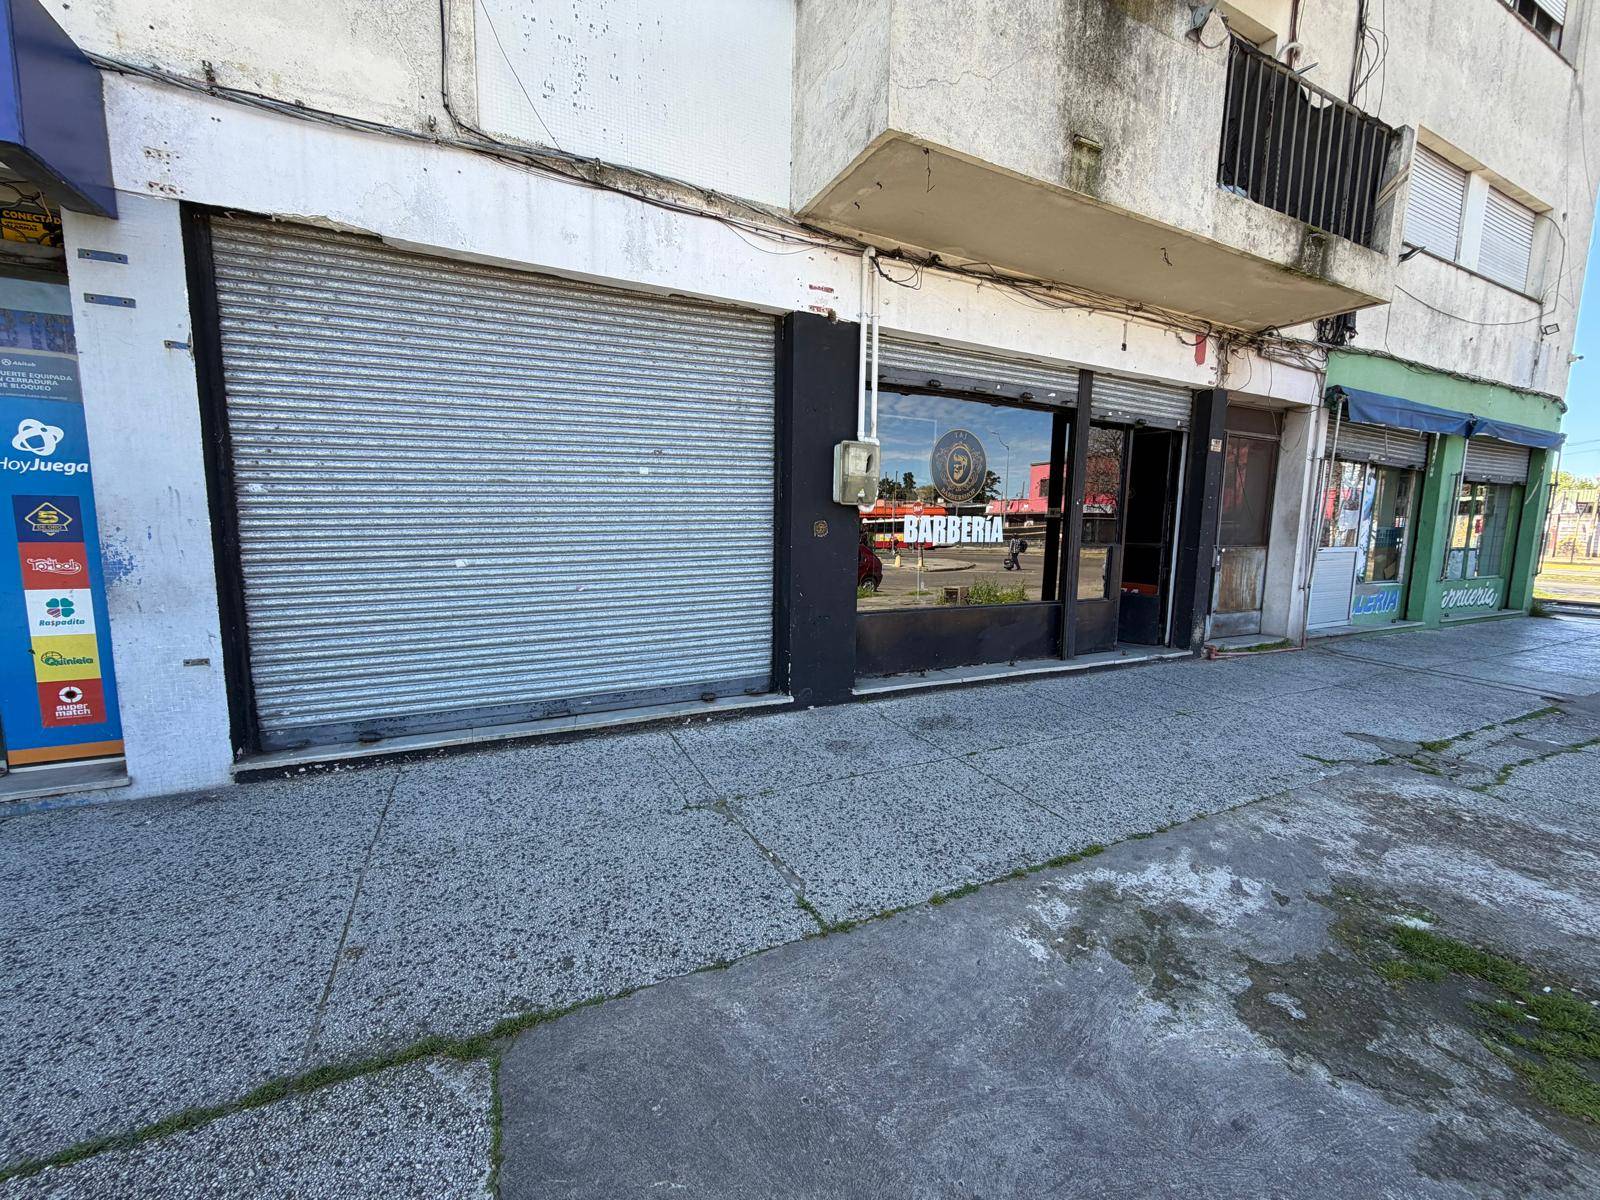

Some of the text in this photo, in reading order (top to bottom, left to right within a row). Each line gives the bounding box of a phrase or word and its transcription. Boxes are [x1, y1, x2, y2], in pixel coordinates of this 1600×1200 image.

[29, 373, 73, 381] EQUIPADA
[11, 383, 51, 391] BLOQUEO
[39, 618, 85, 627] Raspadita
[44, 655, 94, 667] Quiniela
[56, 703, 88, 711] super
[55, 708, 91, 717] match
